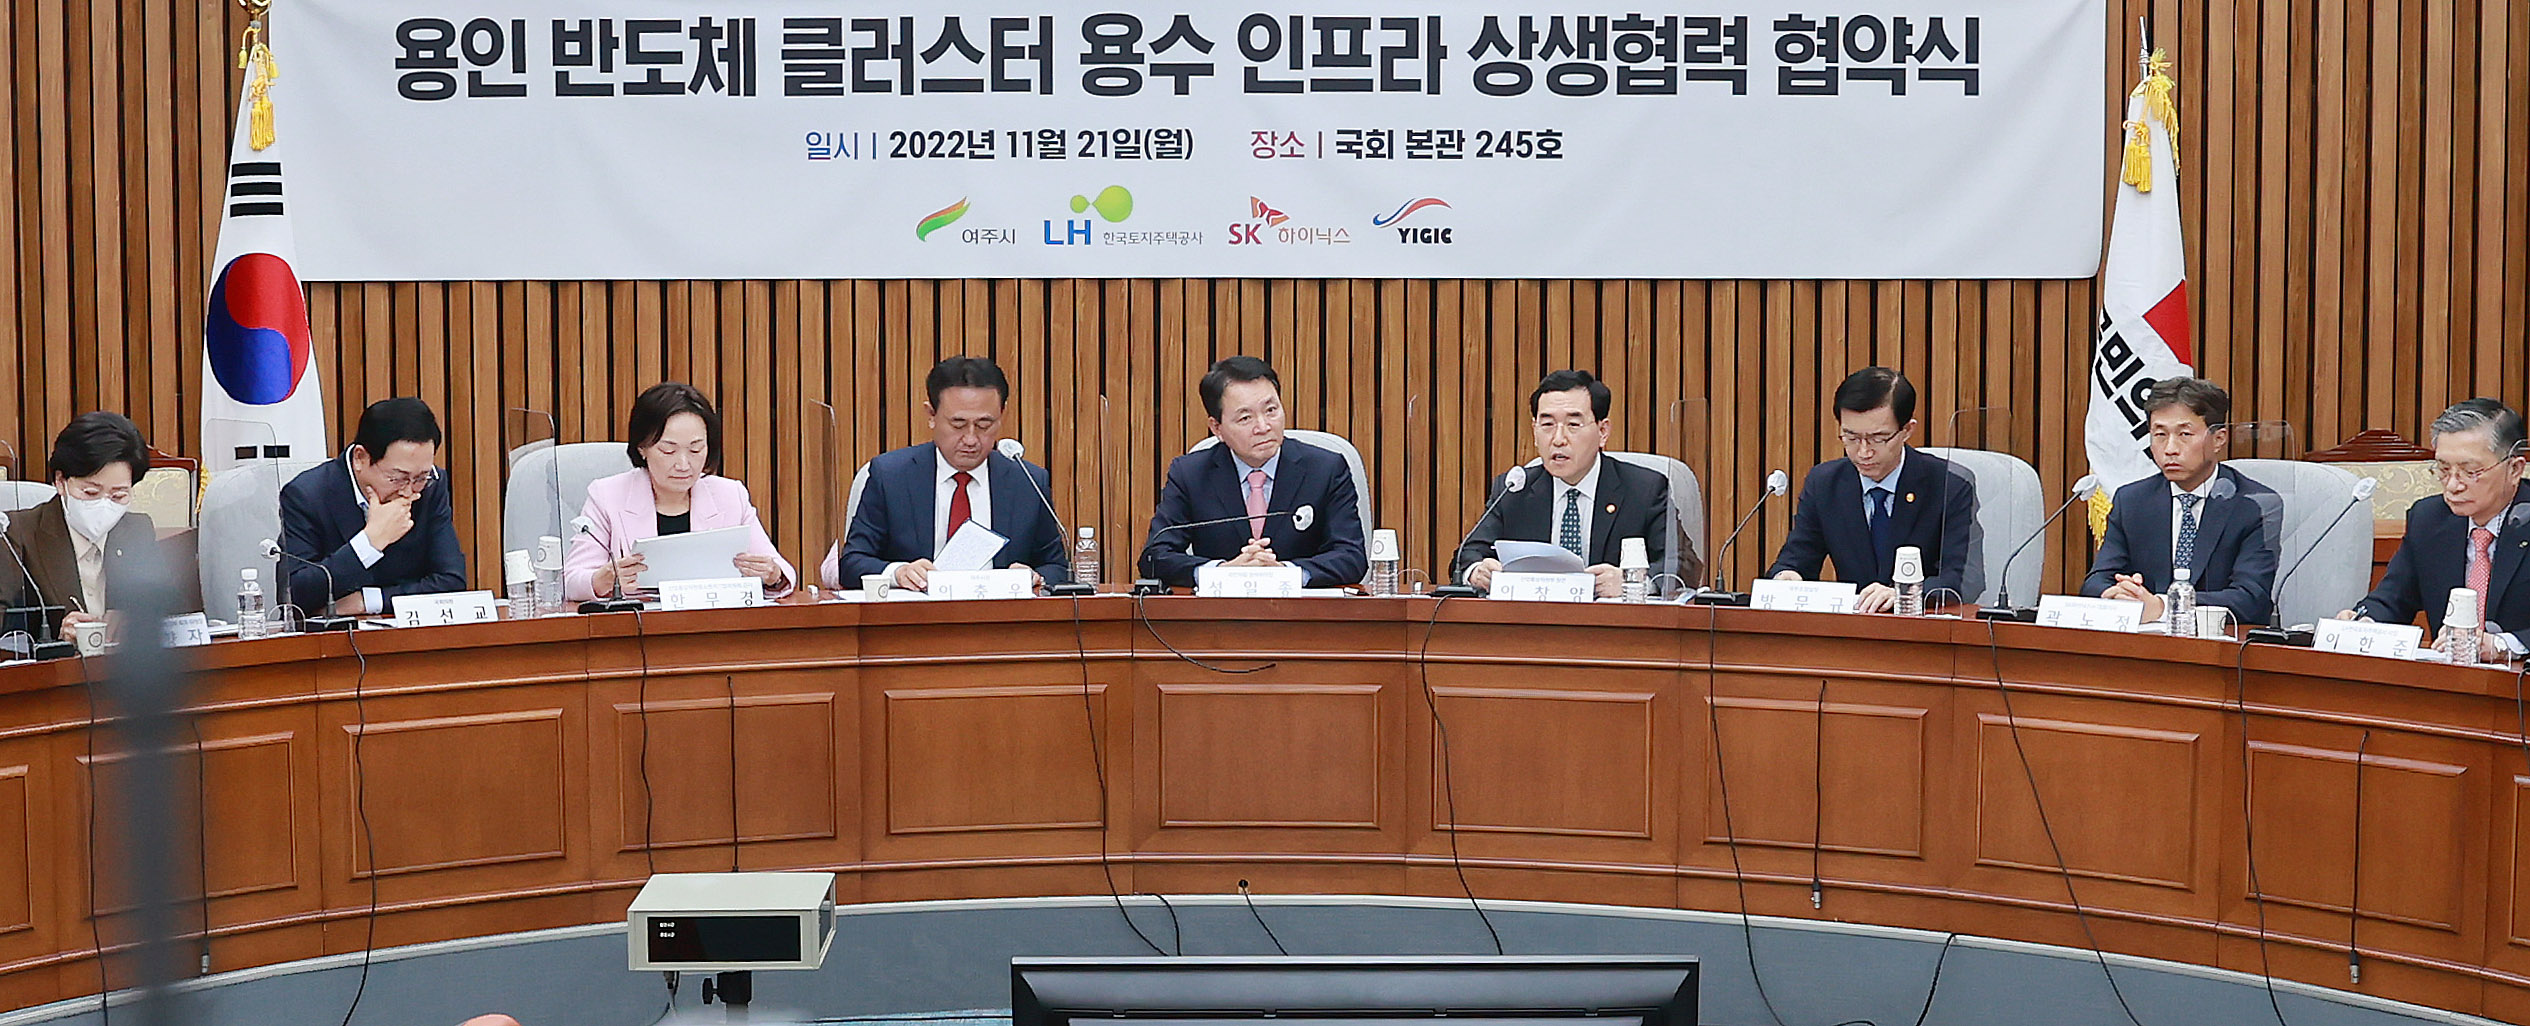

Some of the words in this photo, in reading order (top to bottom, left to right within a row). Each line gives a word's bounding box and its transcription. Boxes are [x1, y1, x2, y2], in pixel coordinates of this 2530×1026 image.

[395, 18, 527, 101] 용인
[552, 16, 756, 97] 반도체
[781, 16, 1053, 96] 클러스터
[1080, 13, 1215, 97] 용수
[1237, 13, 1448, 95] 인프라
[1467, 13, 1748, 97] 상생협력
[1773, 14, 1979, 96] 협약식
[806, 132, 858, 160] 일시
[889, 130, 995, 159] 2022년
[1007, 129, 1066, 160] 11월
[1077, 129, 1193, 160] 21일(월)
[1251, 131, 1305, 159] 장소
[1336, 129, 1394, 160] 국회
[1406, 129, 1466, 159] 본관
[1475, 129, 1563, 159] 245호
[962, 229, 1015, 244] 여주시
[1044, 219, 1091, 245] LH
[1104, 232, 1202, 245] 한국토지주택공사
[1228, 223, 1262, 245] SK
[1279, 227, 1350, 245] 하이닉스
[1397, 228, 1452, 244] YIGIC
